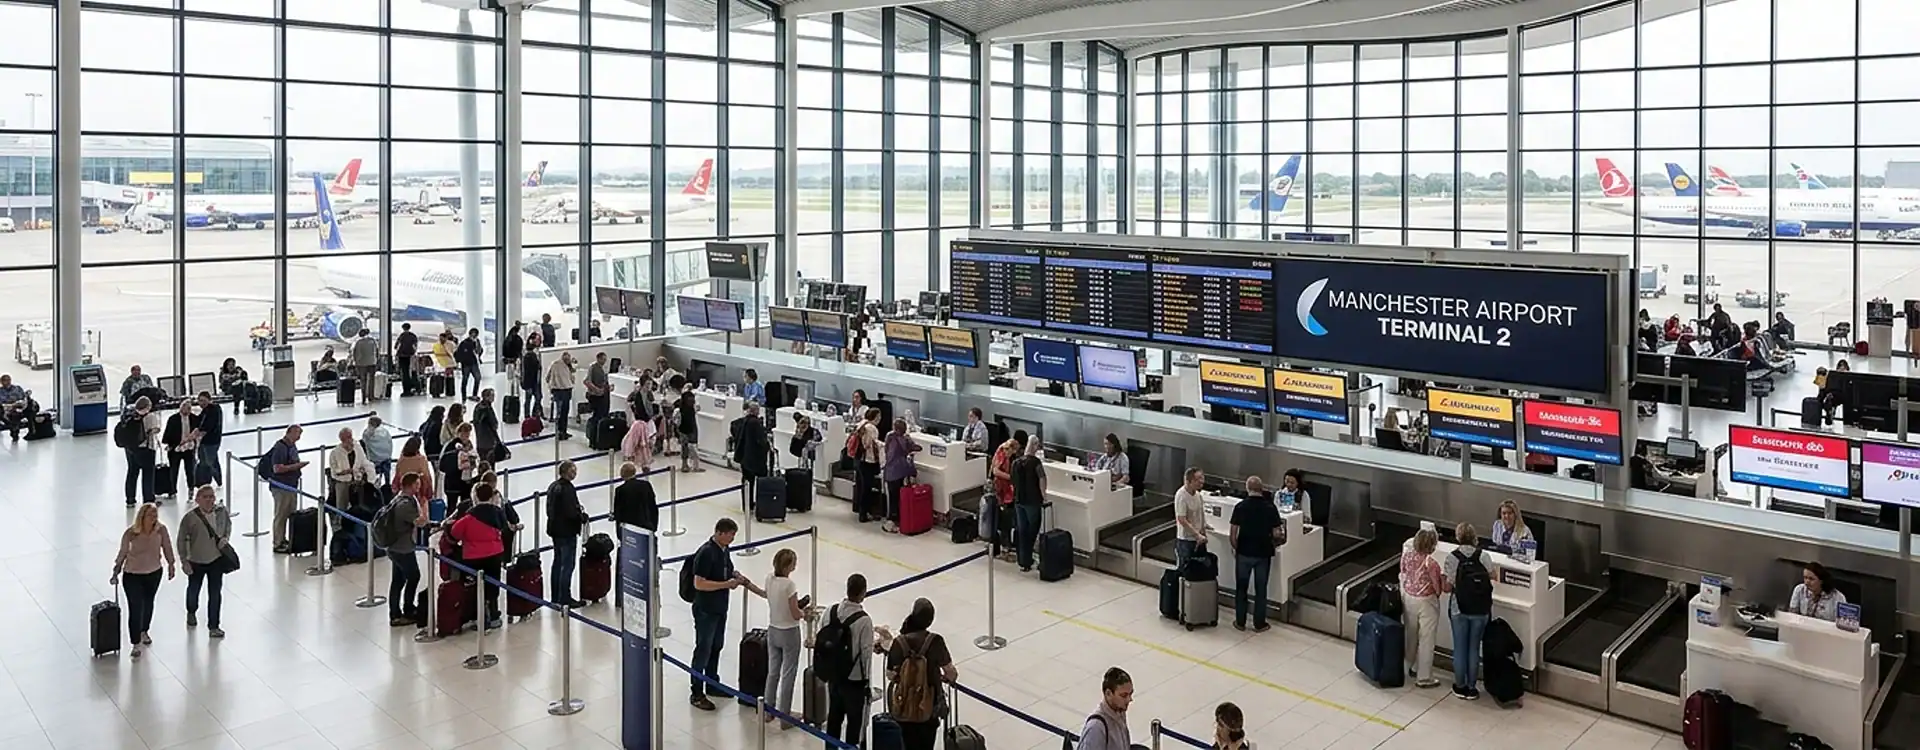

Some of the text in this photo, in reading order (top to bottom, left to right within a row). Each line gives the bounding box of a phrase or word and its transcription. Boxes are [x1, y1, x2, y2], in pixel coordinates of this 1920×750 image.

[1329, 289, 1577, 327] MANCHESTER AIRPORT
[1378, 317, 1511, 347] TERMINAL 2
